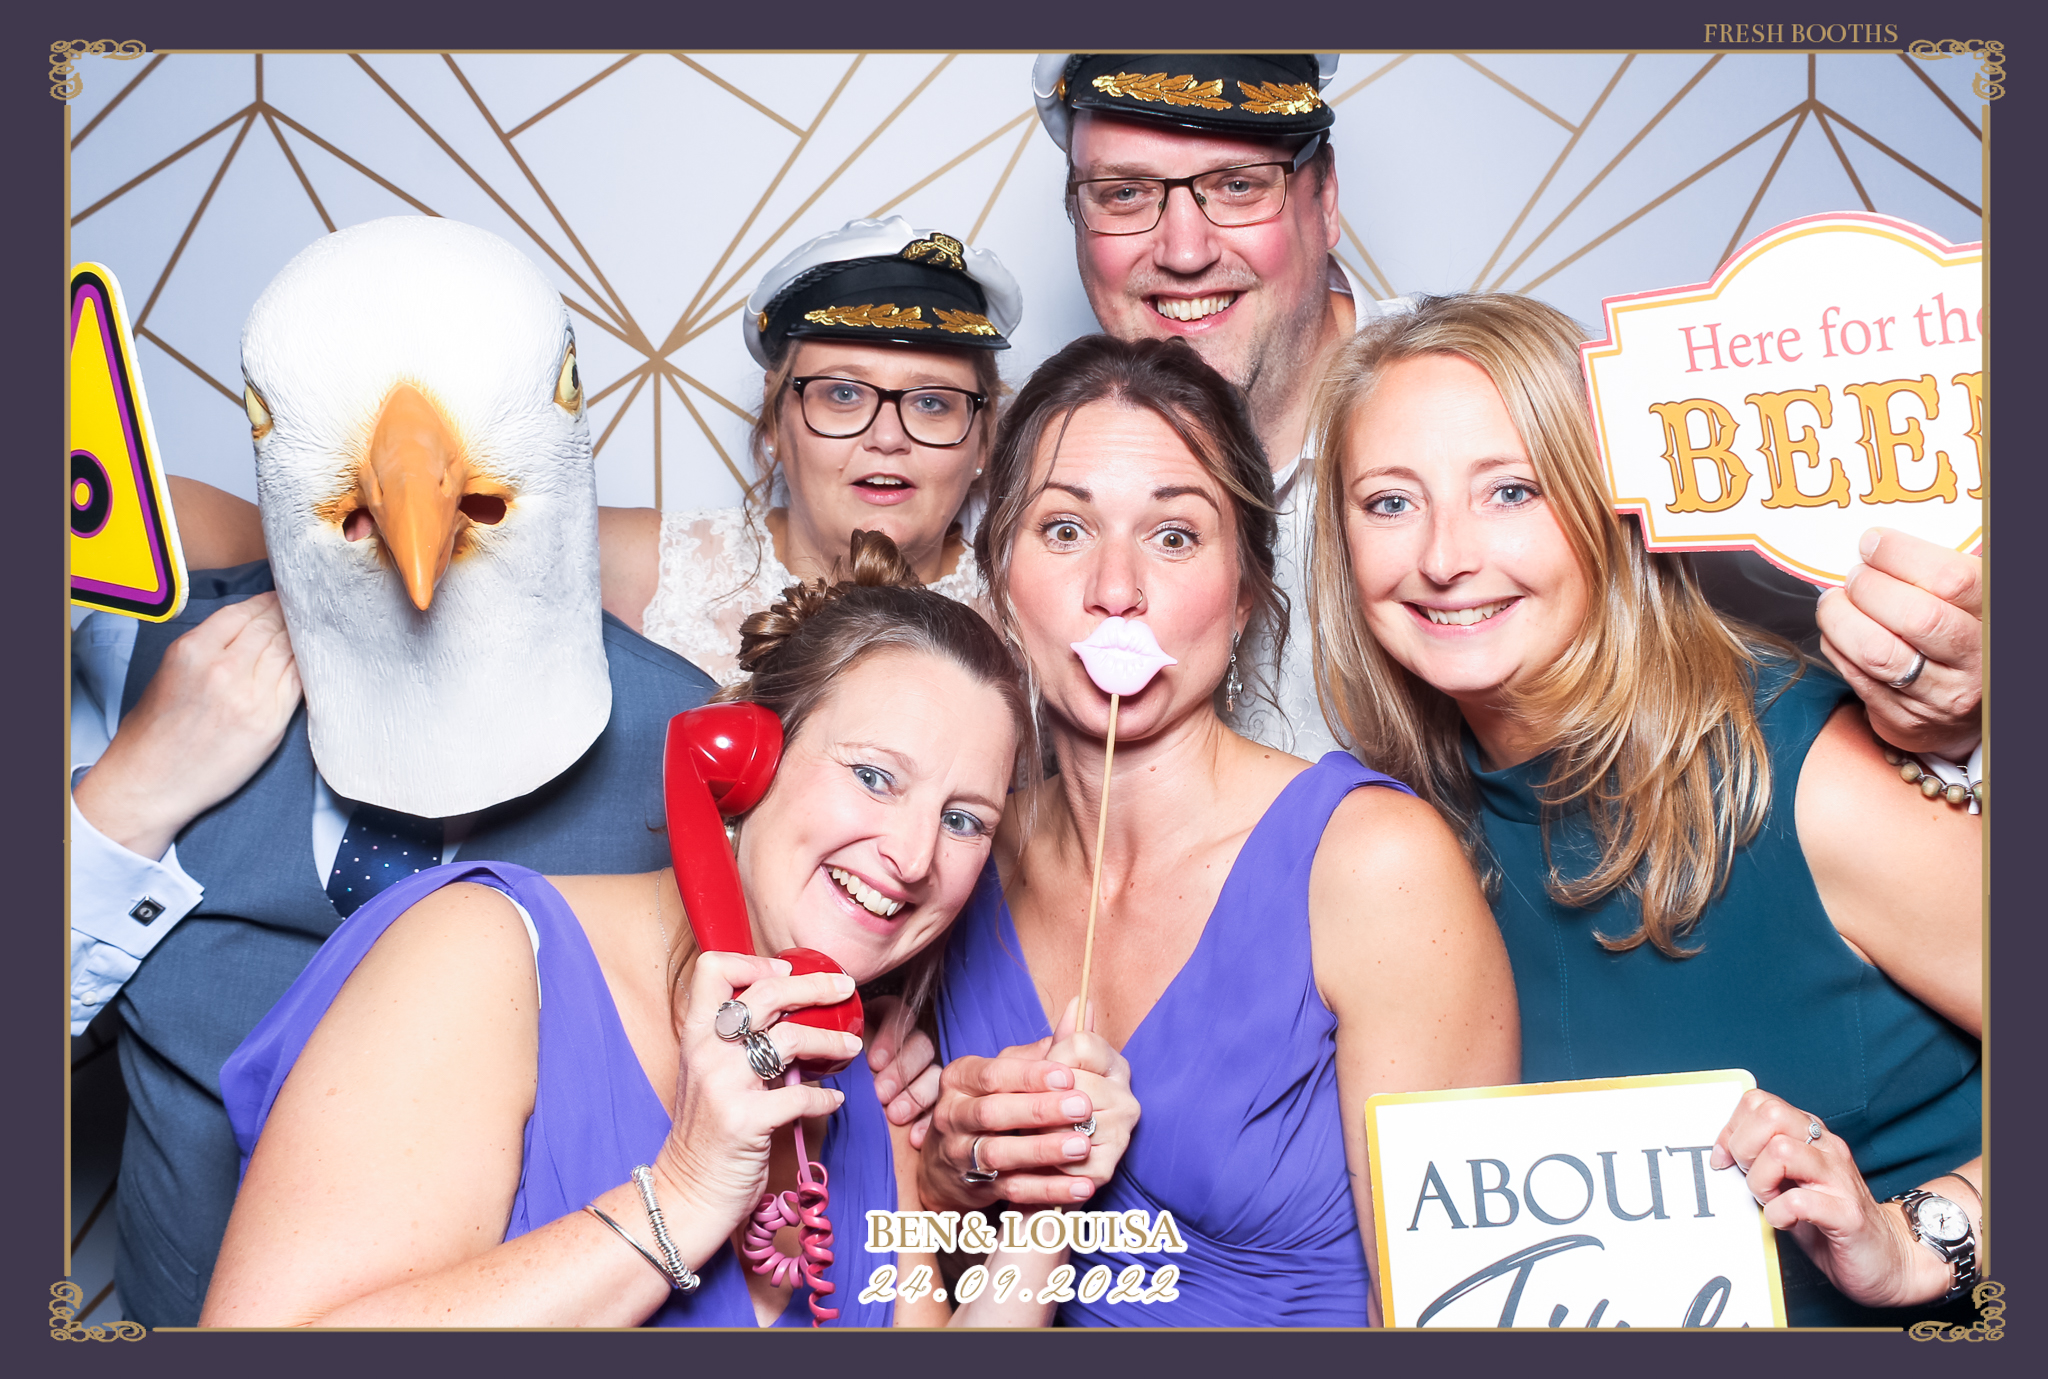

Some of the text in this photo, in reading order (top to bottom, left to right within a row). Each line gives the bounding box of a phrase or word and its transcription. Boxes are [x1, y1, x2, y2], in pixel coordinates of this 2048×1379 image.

[1677, 321, 1803, 374] Here
[1818, 305, 1897, 359] for
[1406, 1145, 1716, 1232] ABOUT
